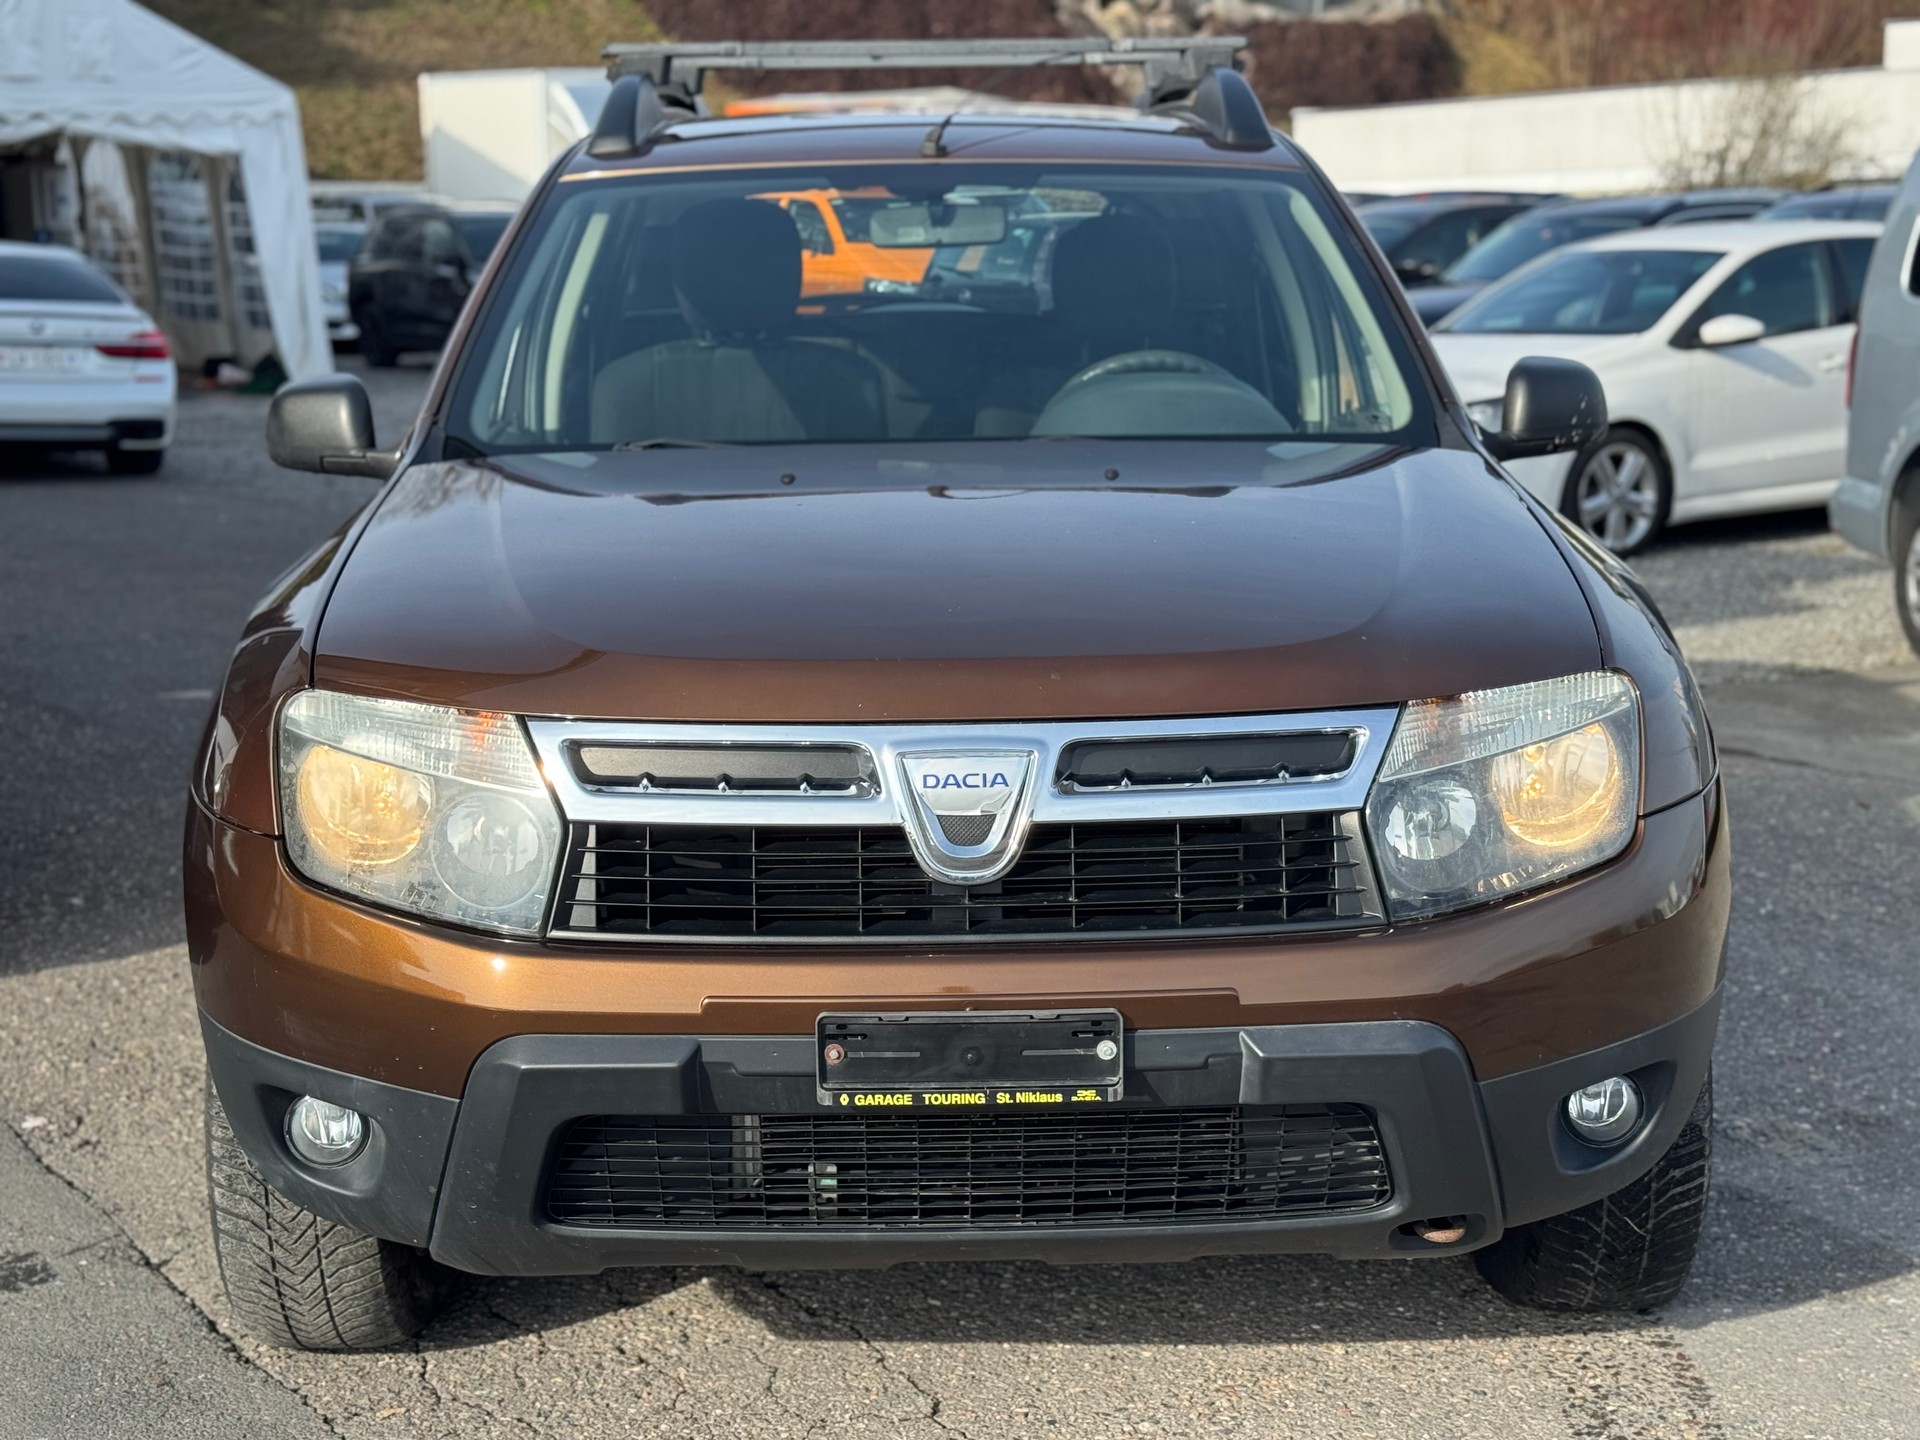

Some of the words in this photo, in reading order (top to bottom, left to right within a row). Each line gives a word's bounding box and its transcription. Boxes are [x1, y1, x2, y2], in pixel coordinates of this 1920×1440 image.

[922, 772, 1010, 789] DACIA
[854, 1094, 914, 1106] GARAGE
[922, 1093, 986, 1105] TOURING
[996, 1092, 1014, 1104] St.
[1015, 1091, 1064, 1104] Niklaus
